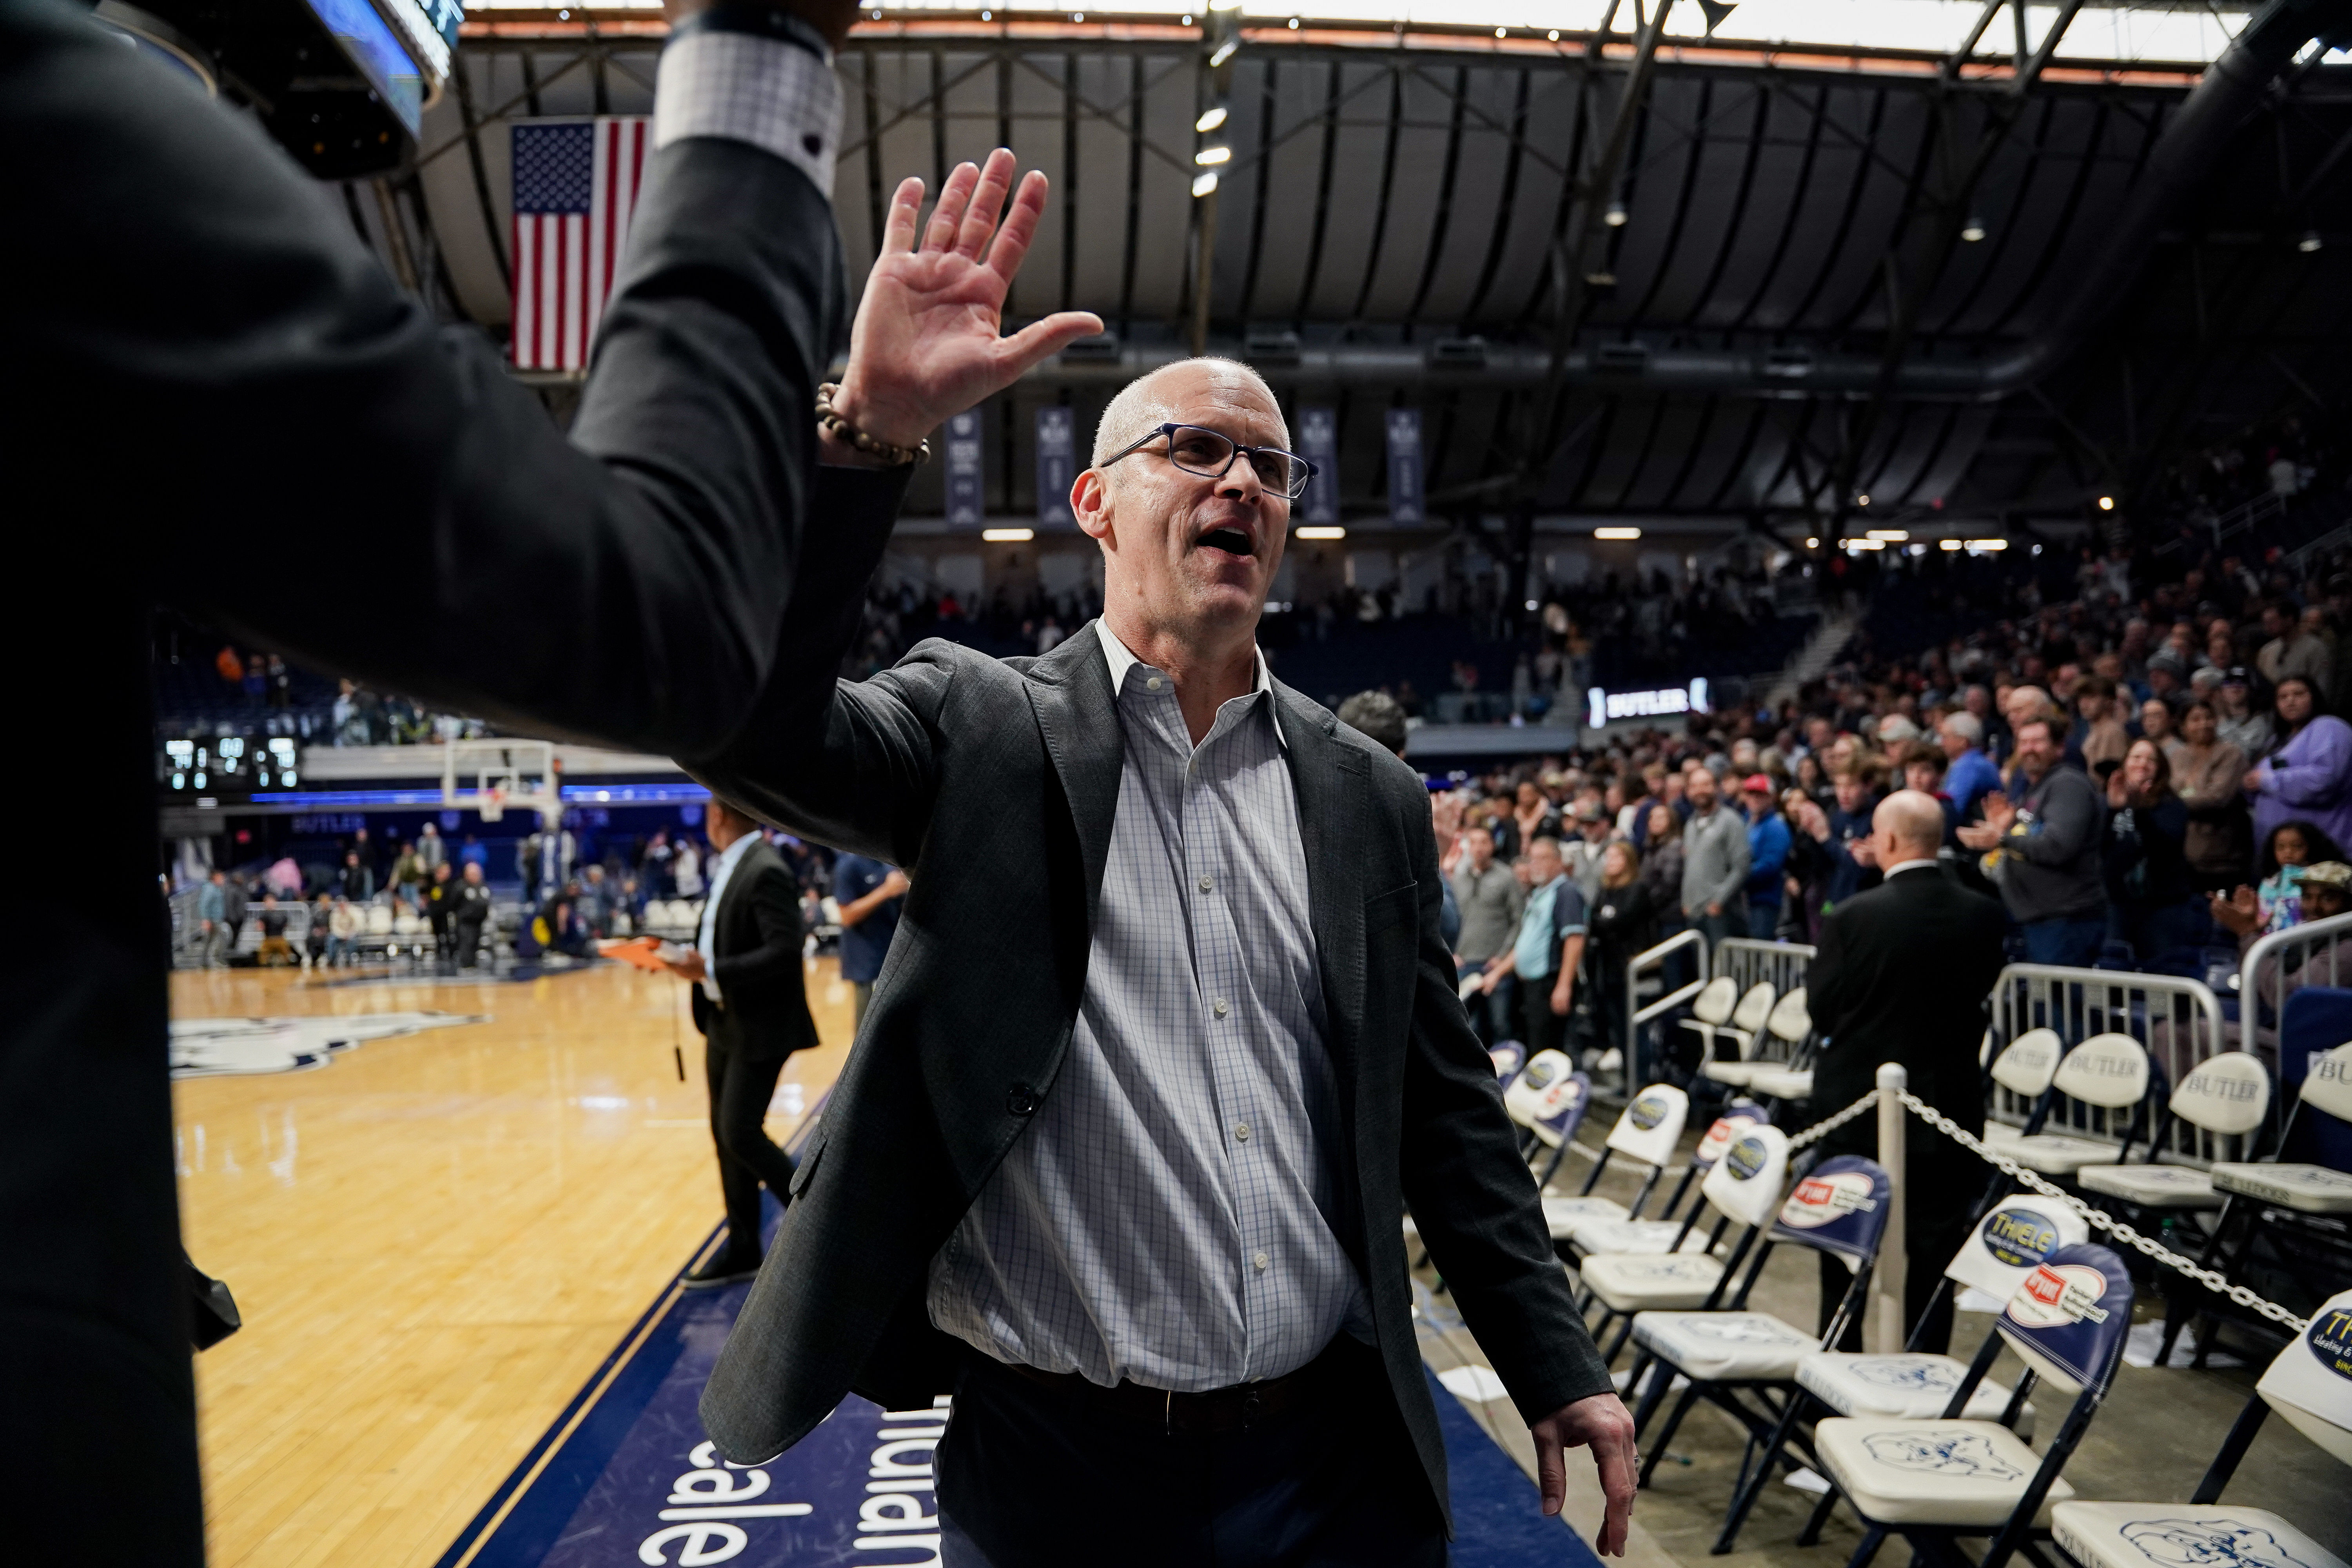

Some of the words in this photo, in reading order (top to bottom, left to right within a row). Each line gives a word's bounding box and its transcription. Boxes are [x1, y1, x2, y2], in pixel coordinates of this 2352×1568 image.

[1607, 688, 1690, 718] BUTLER
[2069, 1056, 2139, 1077] BUTLER
[2187, 1074, 2259, 1102] BUTLER
[1993, 1212, 2054, 1253] THIELE
